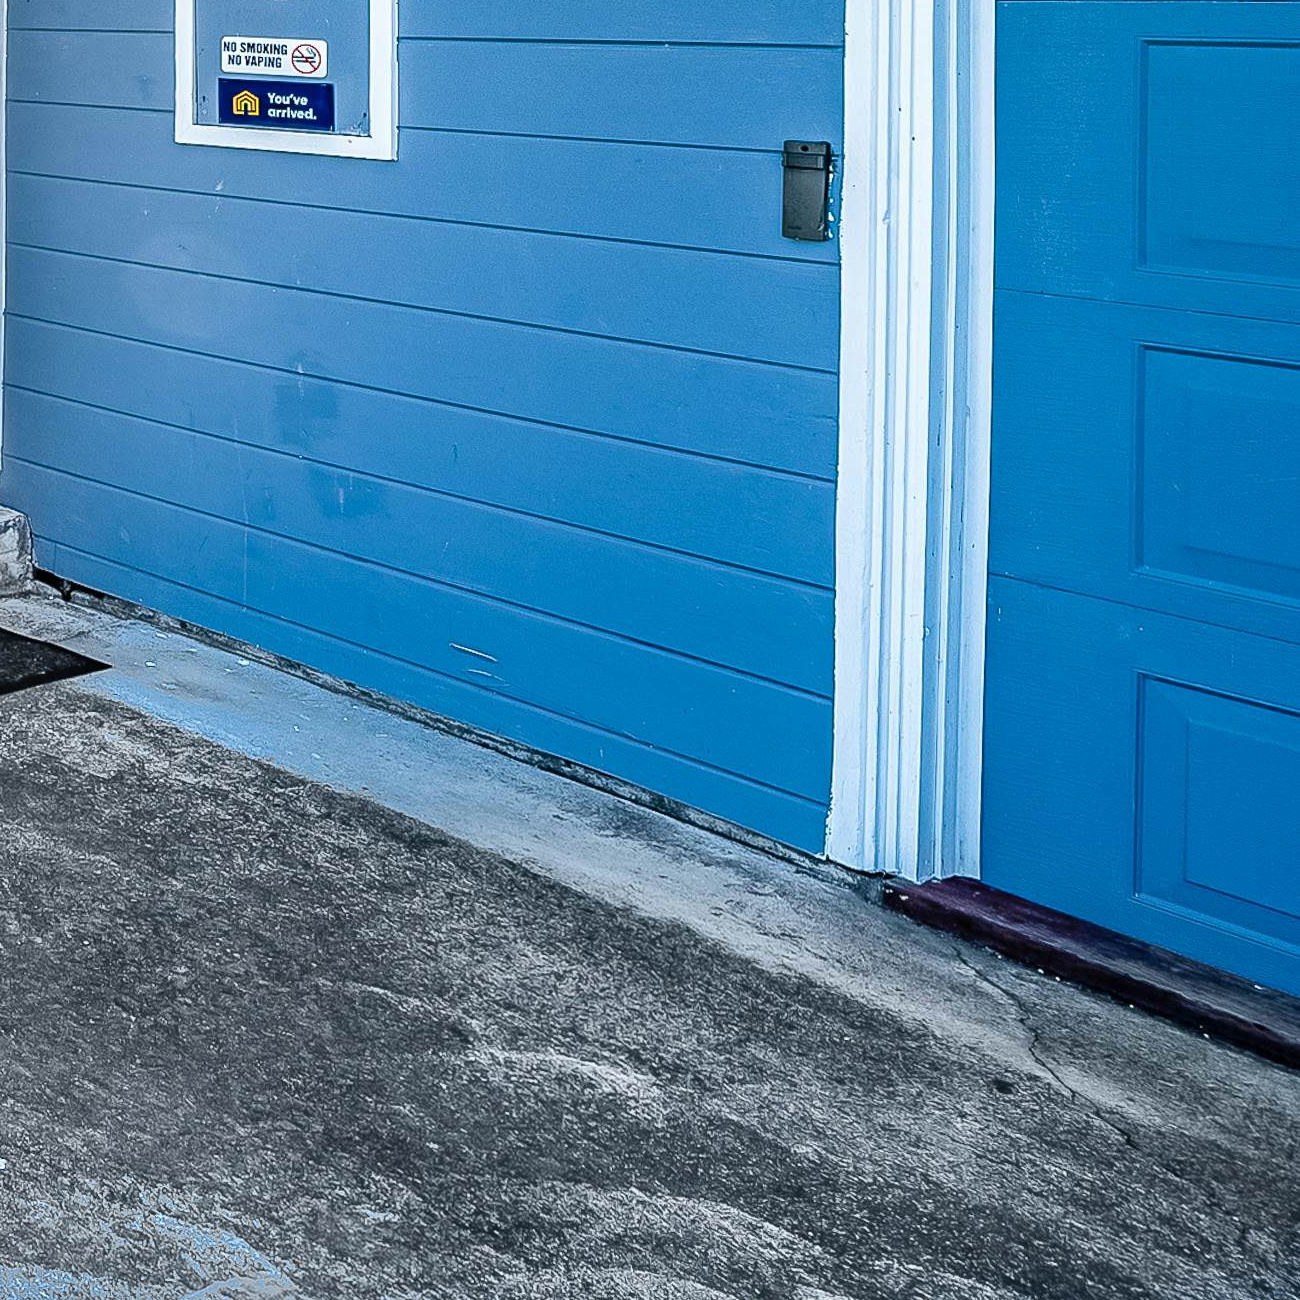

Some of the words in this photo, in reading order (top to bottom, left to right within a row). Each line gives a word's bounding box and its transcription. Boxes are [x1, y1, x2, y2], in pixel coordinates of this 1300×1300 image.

[223, 41, 237, 53] NO
[240, 42, 288, 55] SMOKING
[228, 55, 242, 66] NO
[245, 55, 282, 69] VAPING
[267, 92, 309, 106] You've
[267, 107, 317, 120] arrived.
